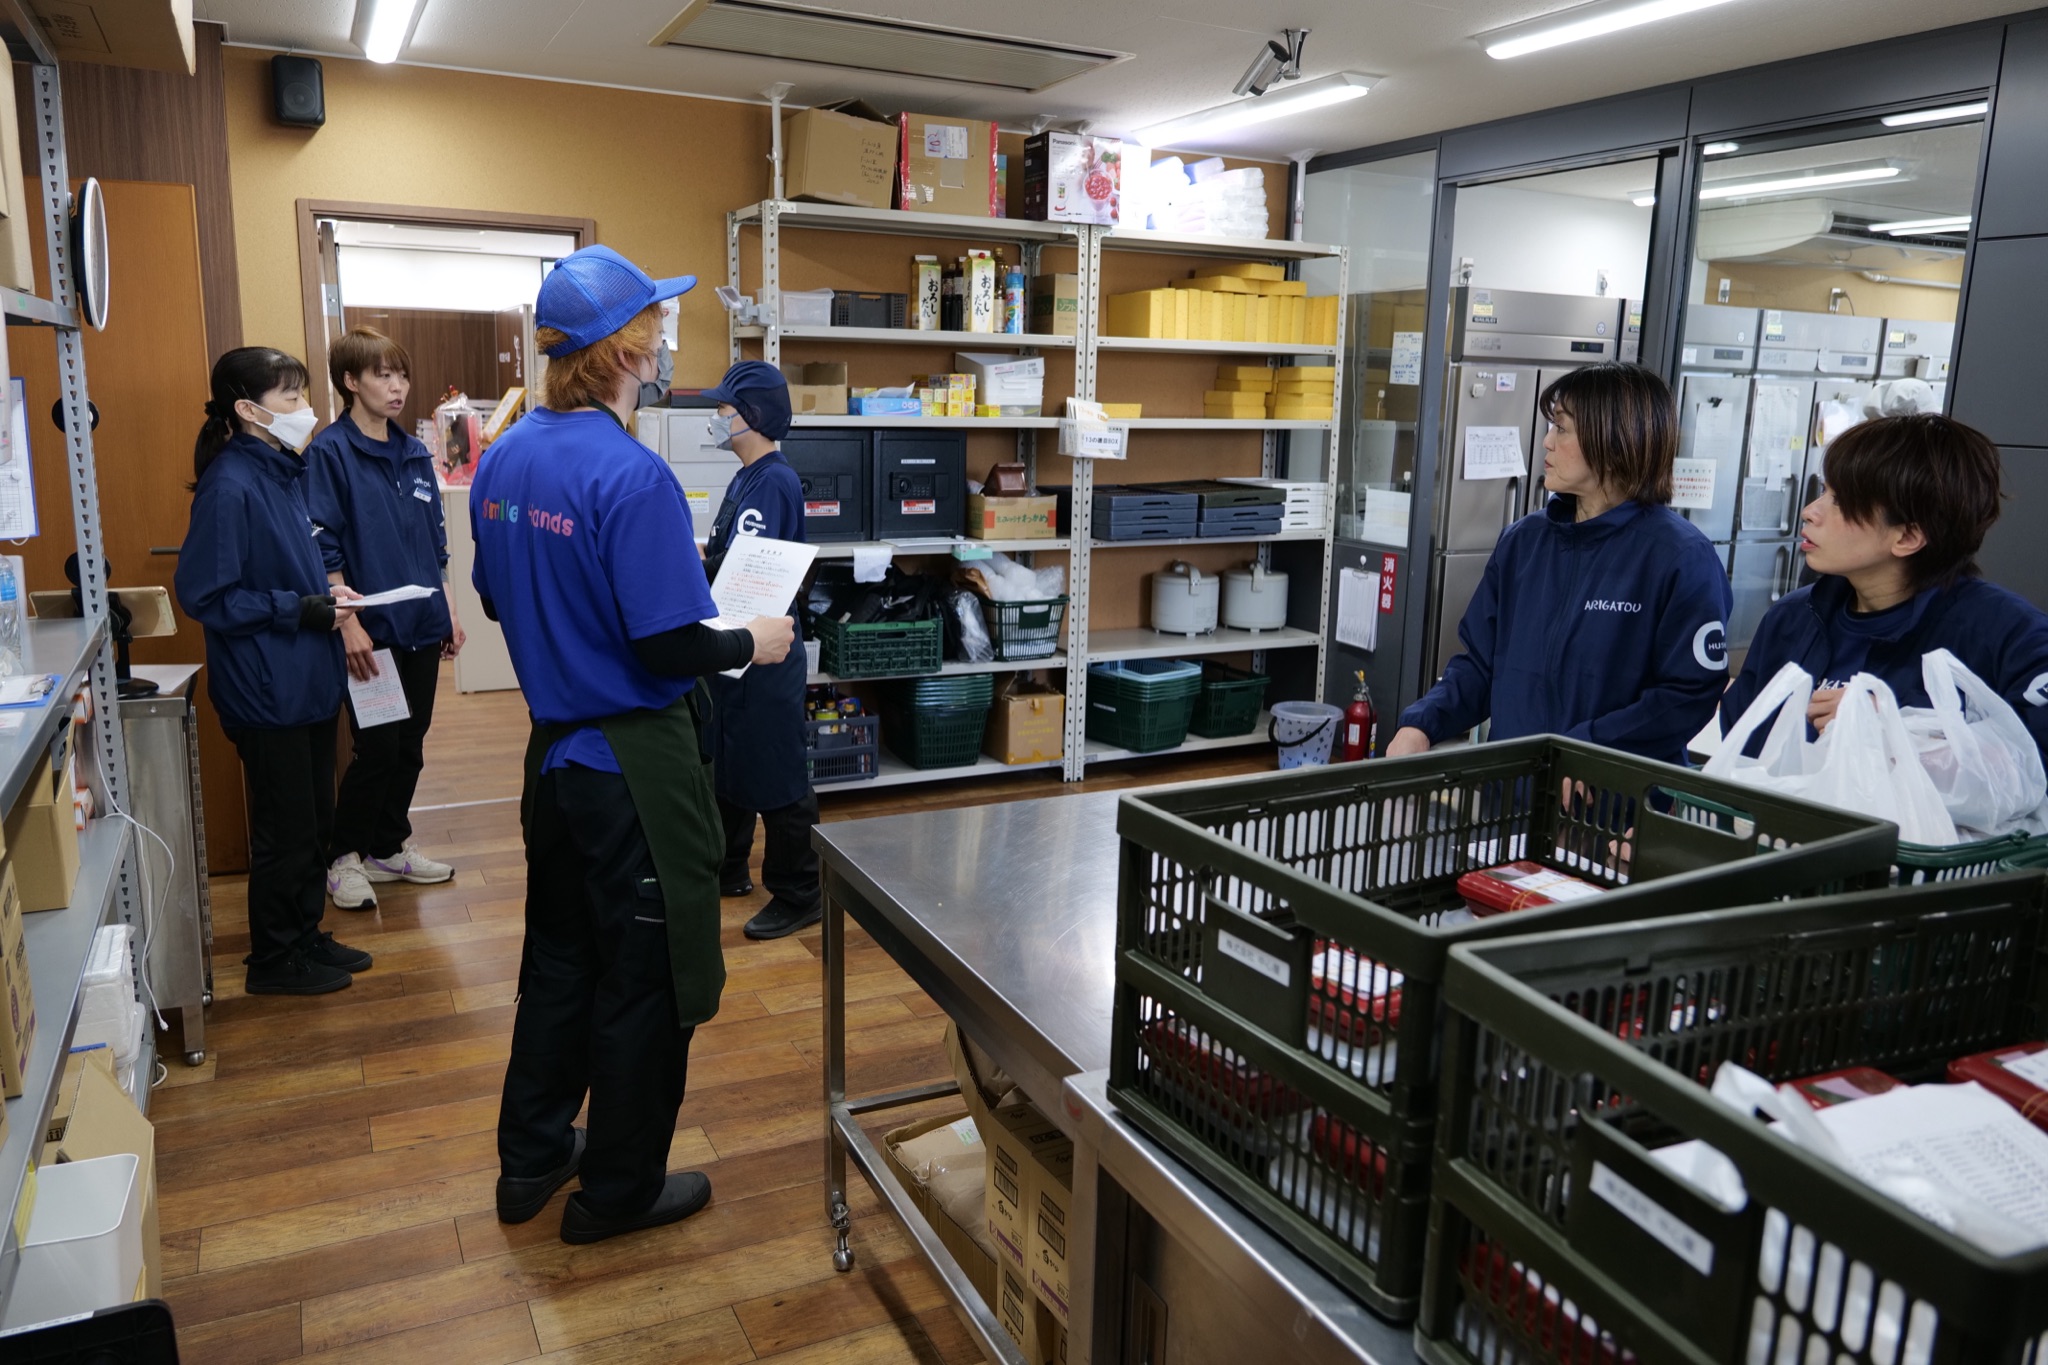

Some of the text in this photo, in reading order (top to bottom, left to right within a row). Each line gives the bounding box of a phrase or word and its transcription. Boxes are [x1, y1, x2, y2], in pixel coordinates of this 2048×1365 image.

[921, 296, 931, 318] だれ
[928, 278, 939, 315] おろし
[973, 294, 984, 316] だれ
[980, 275, 992, 313] おろし
[482, 498, 519, 524] Smile
[1381, 557, 1396, 609] 消火器
[1584, 599, 1642, 613] ARIGATOU
